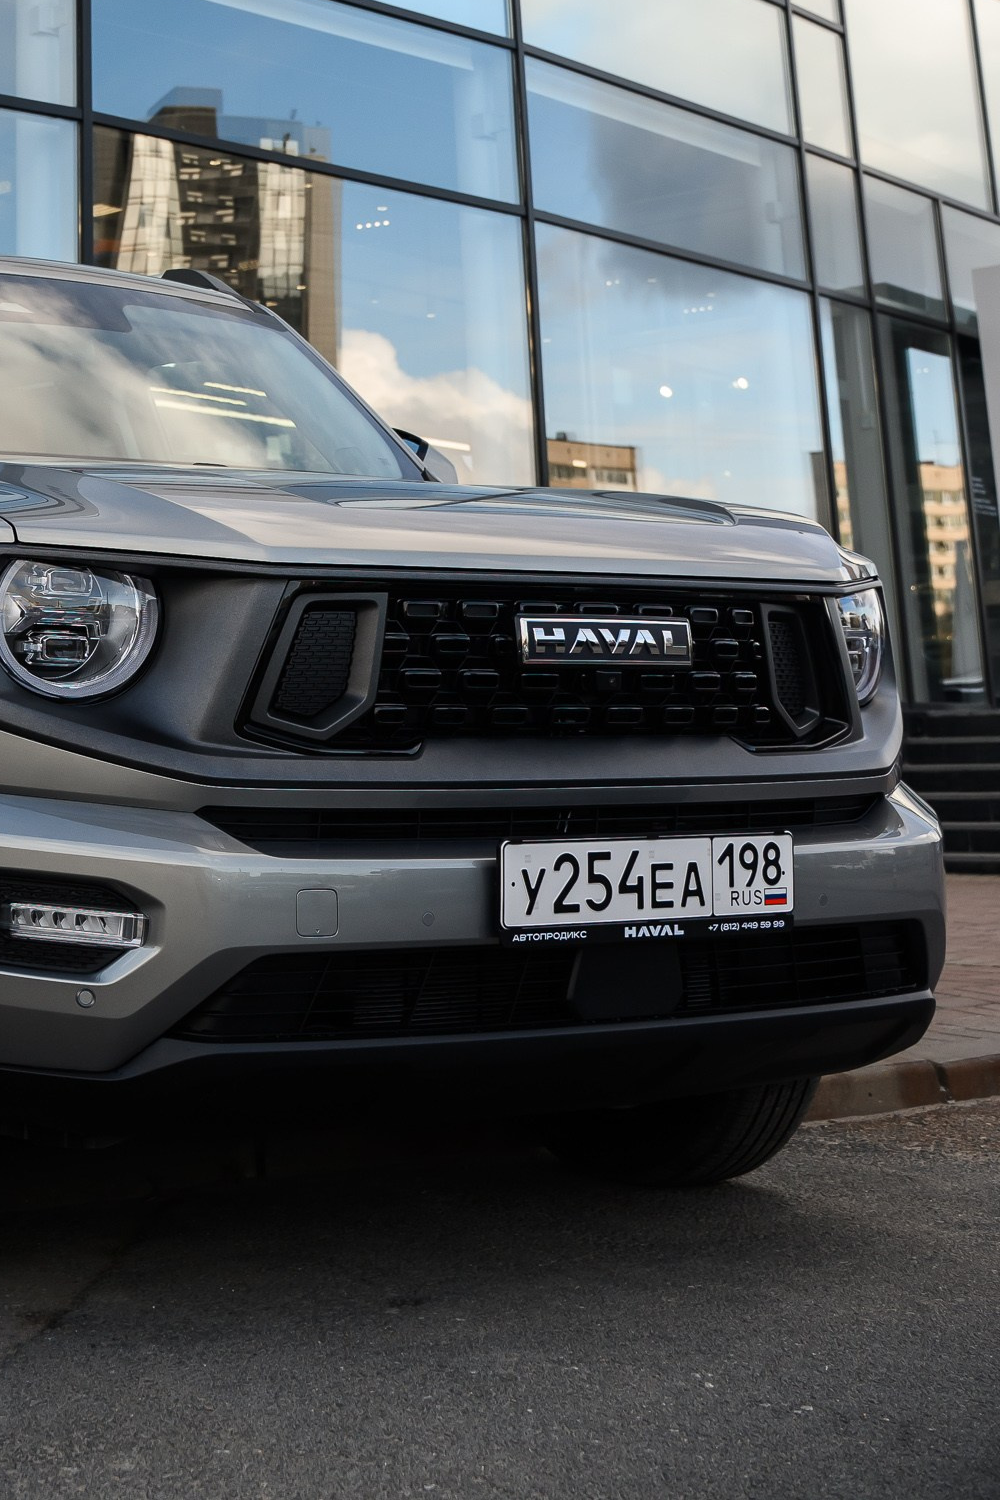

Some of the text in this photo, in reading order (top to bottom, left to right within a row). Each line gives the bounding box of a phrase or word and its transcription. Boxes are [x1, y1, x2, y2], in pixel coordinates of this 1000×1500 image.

[532, 627, 687, 656] HAVAL
[717, 841, 781, 888] 198
[730, 889, 762, 907] RUS
[624, 924, 685, 938] HAVAL
[708, 920, 785, 932] +7 (812) 449 59 99
[512, 930, 587, 943] АВТОПРОДИКС
